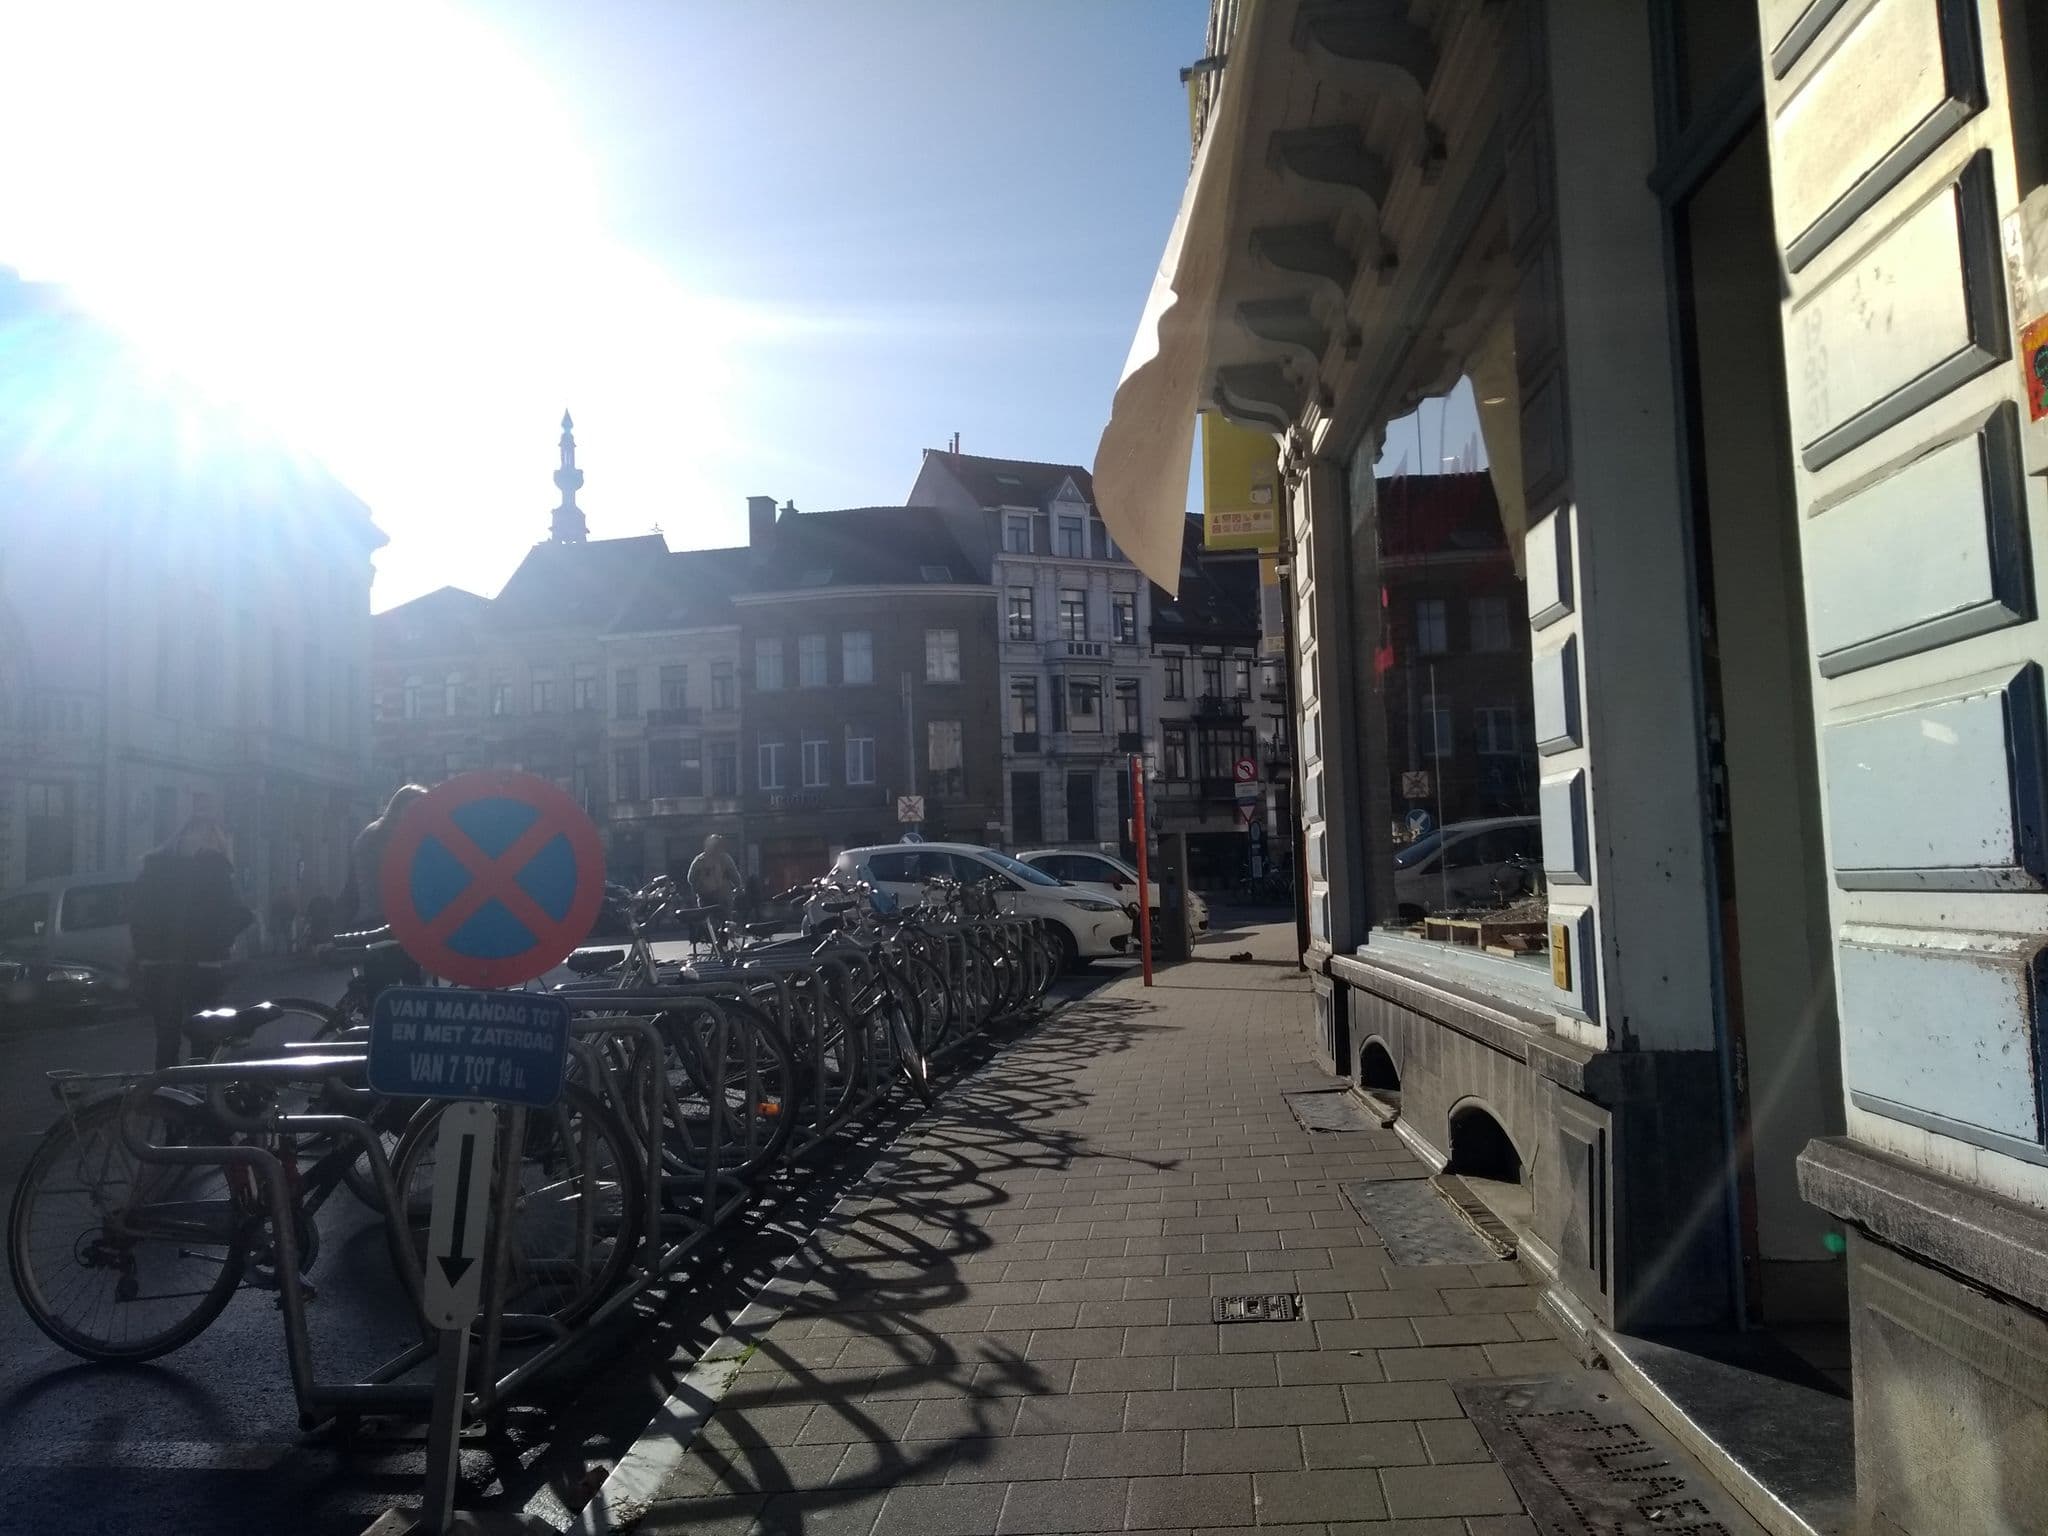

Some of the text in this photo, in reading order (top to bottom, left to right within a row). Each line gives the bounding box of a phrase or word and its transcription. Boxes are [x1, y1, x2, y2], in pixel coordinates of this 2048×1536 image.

[390, 1000, 560, 1027] VAN MAANDAG TOT
[392, 1024, 553, 1051] EN MET ZATERDAG
[411, 1054, 444, 1084] VAN
[449, 1056, 459, 1084] 7
[464, 1056, 495, 1086] TOT
